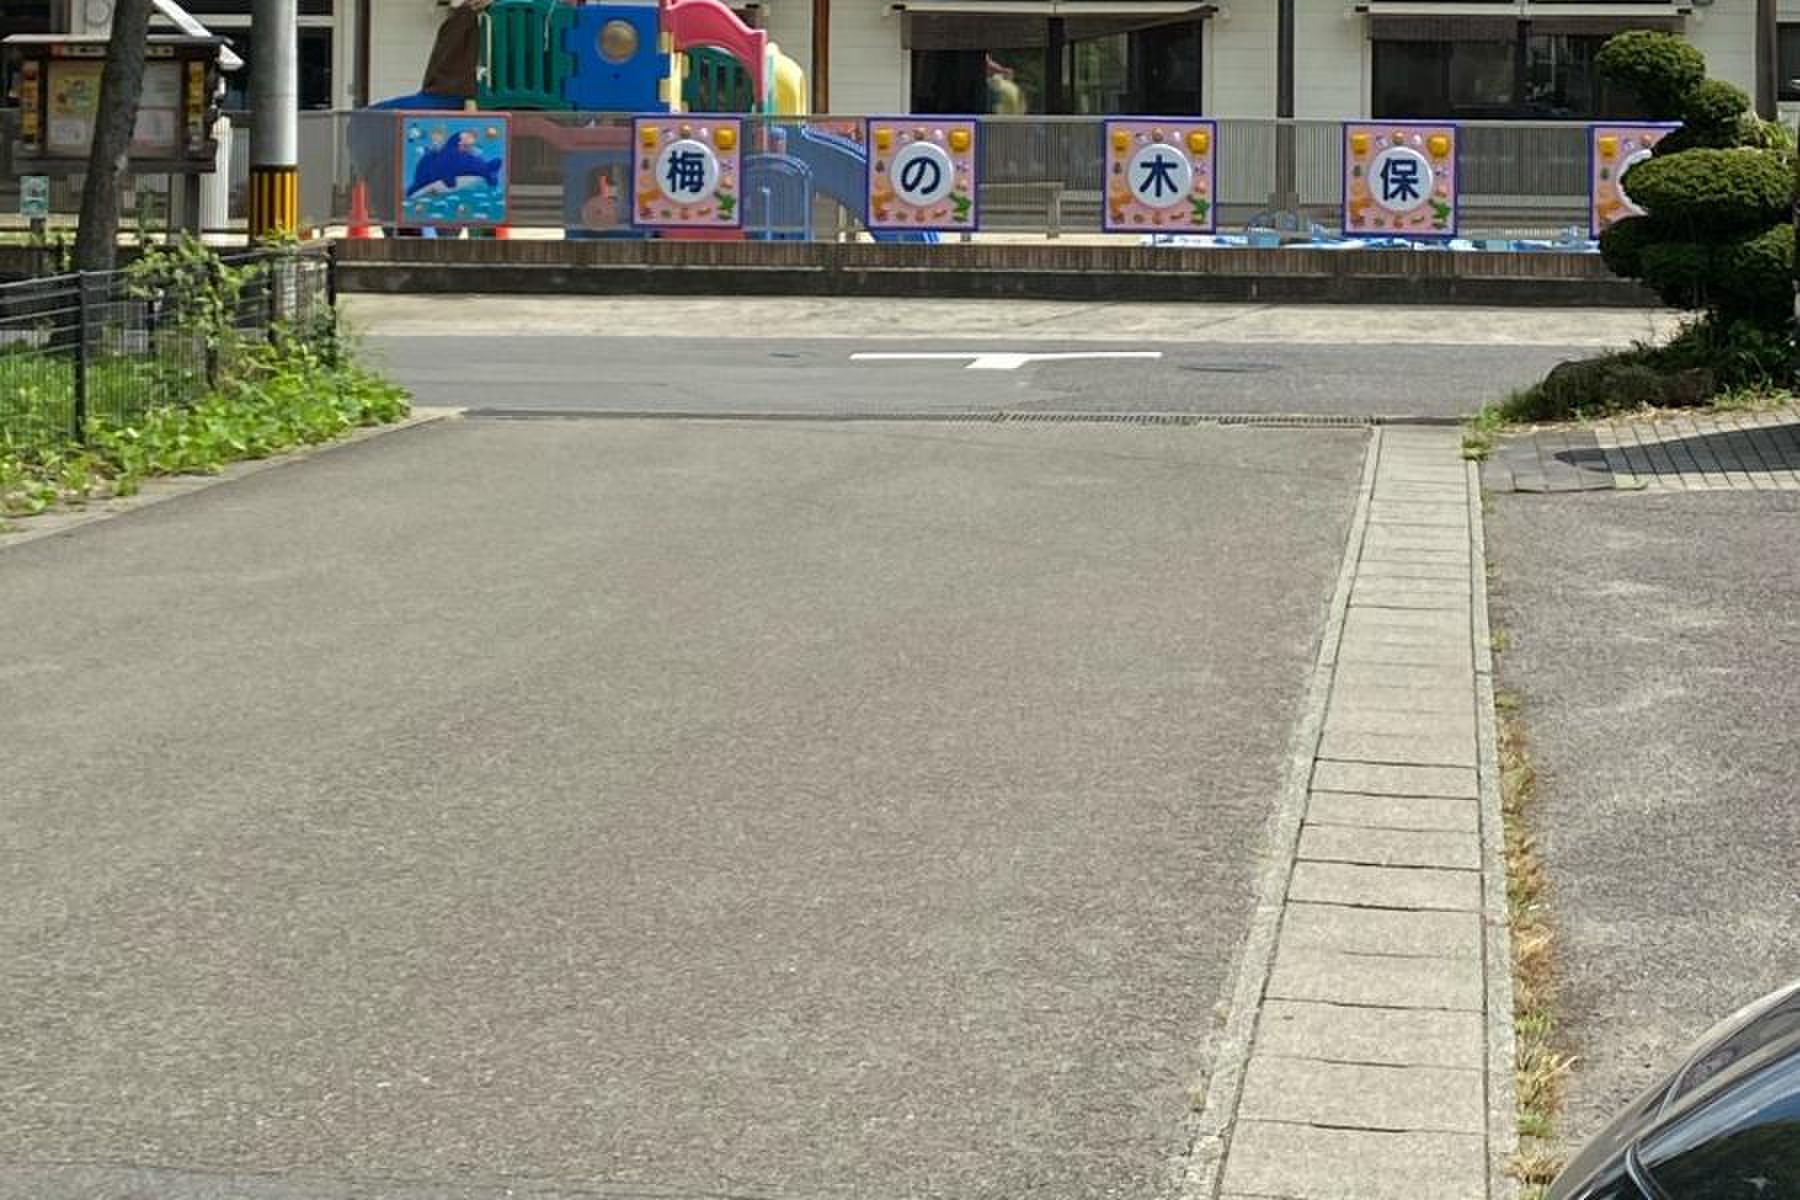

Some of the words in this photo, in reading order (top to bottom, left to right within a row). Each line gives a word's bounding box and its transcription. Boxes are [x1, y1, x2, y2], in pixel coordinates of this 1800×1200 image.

[667, 151, 706, 193] 梅
[901, 156, 942, 195] の
[1139, 154, 1179, 197] 木
[1379, 157, 1420, 201] 保
